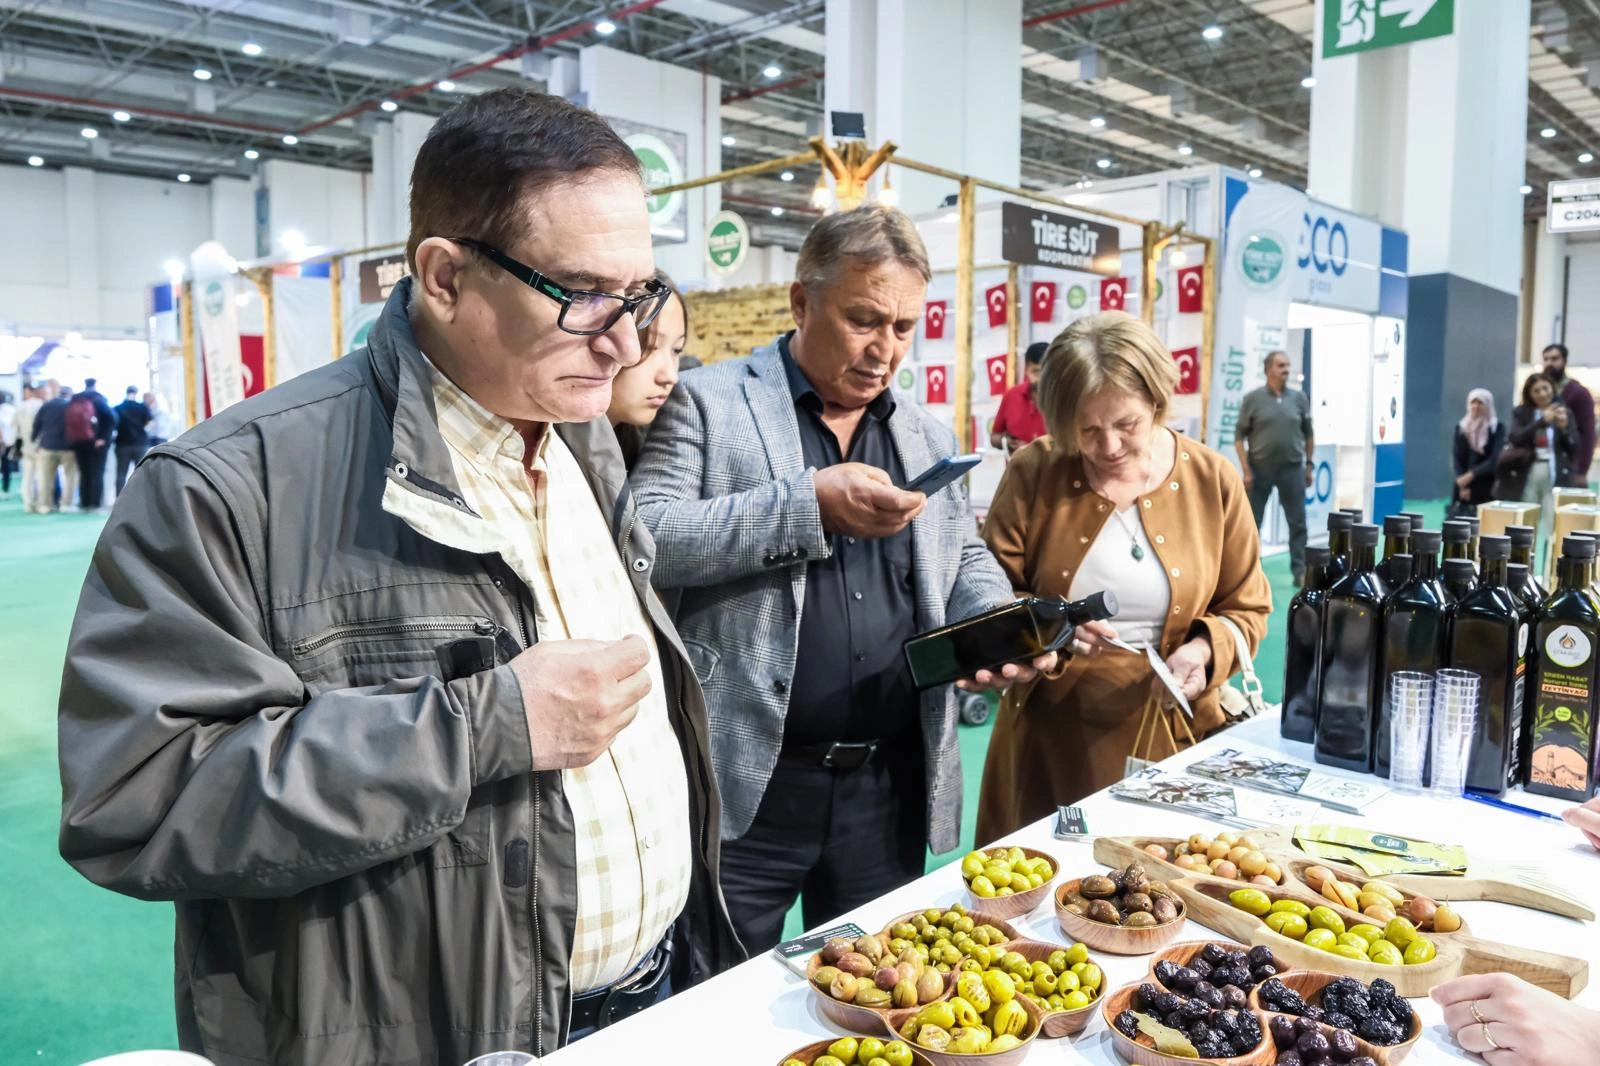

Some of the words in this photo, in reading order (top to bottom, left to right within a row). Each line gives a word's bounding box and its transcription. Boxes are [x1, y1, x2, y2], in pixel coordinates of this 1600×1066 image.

[1031, 214, 1067, 250] TİRE
[1068, 223, 1099, 255] SÜT
[1221, 346, 1246, 391] SÜT
